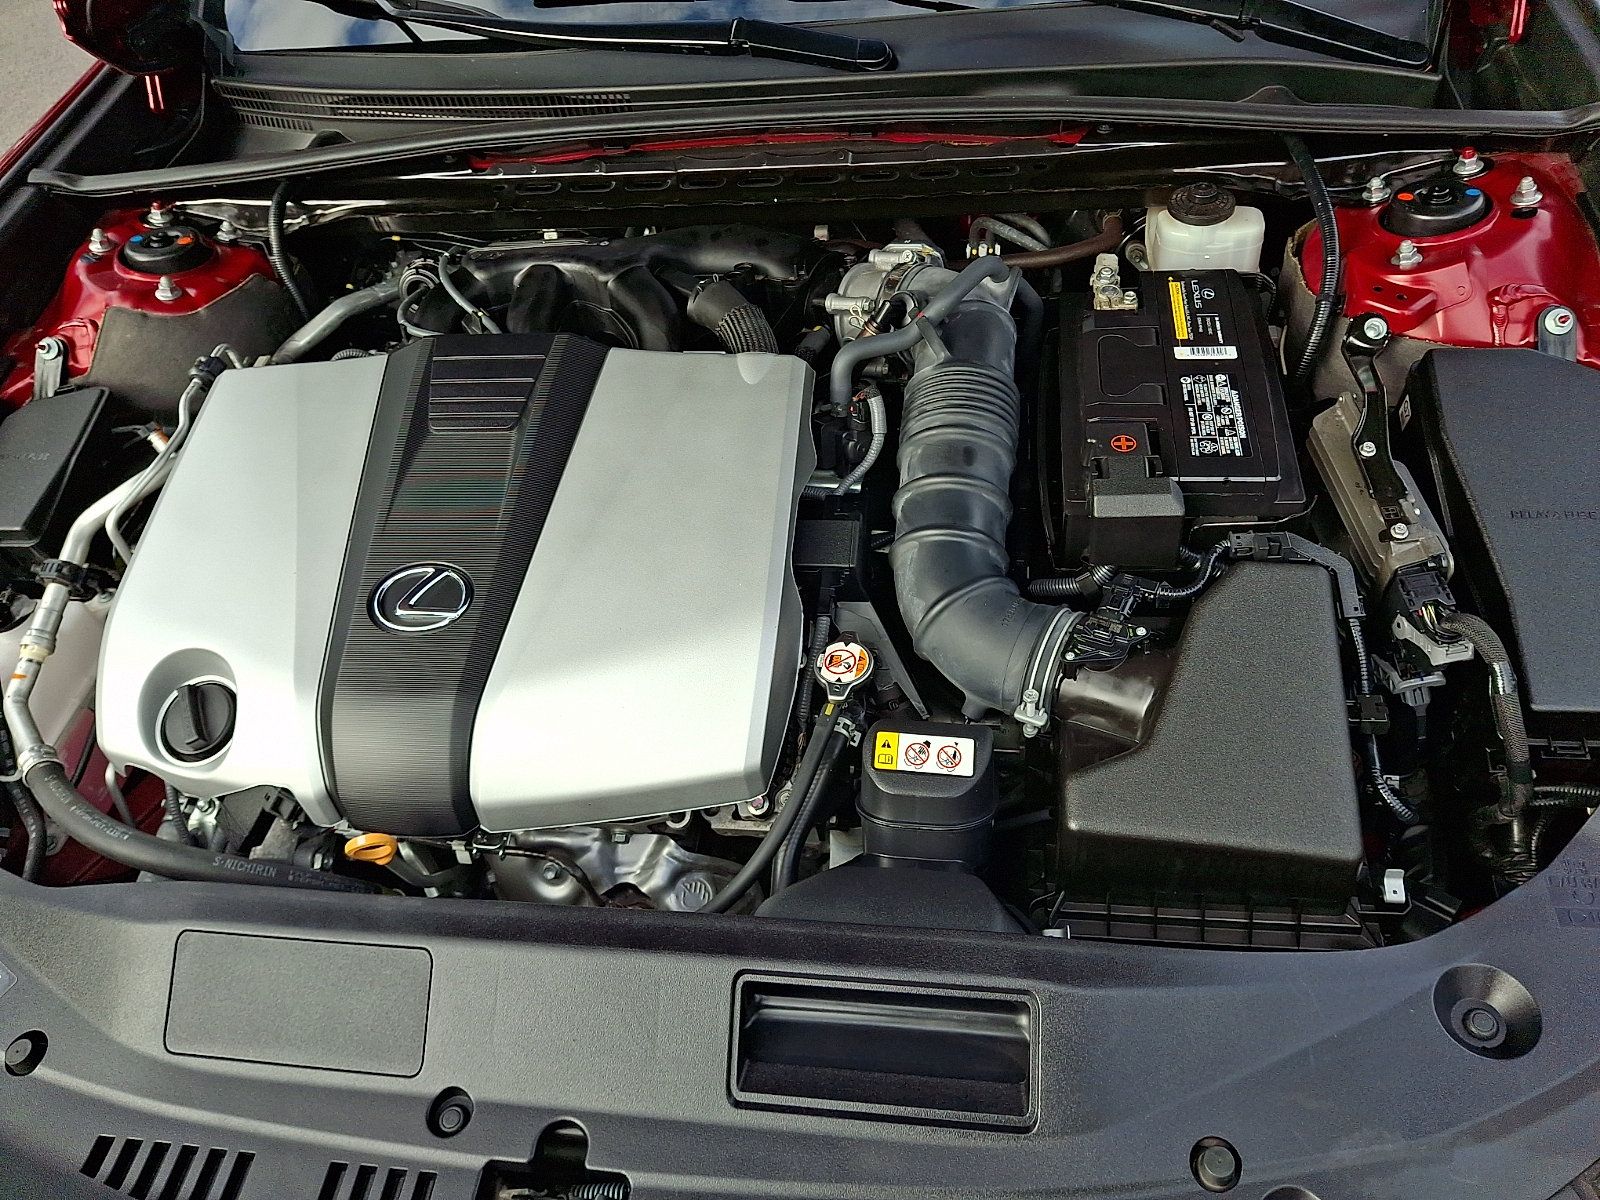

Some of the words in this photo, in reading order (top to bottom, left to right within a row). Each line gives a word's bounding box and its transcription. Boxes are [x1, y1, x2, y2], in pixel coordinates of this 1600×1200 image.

[1191, 279, 1203, 309] LEXUS
[1231, 394, 1243, 416] DANGER
[1236, 416, 1247, 439] POISON
